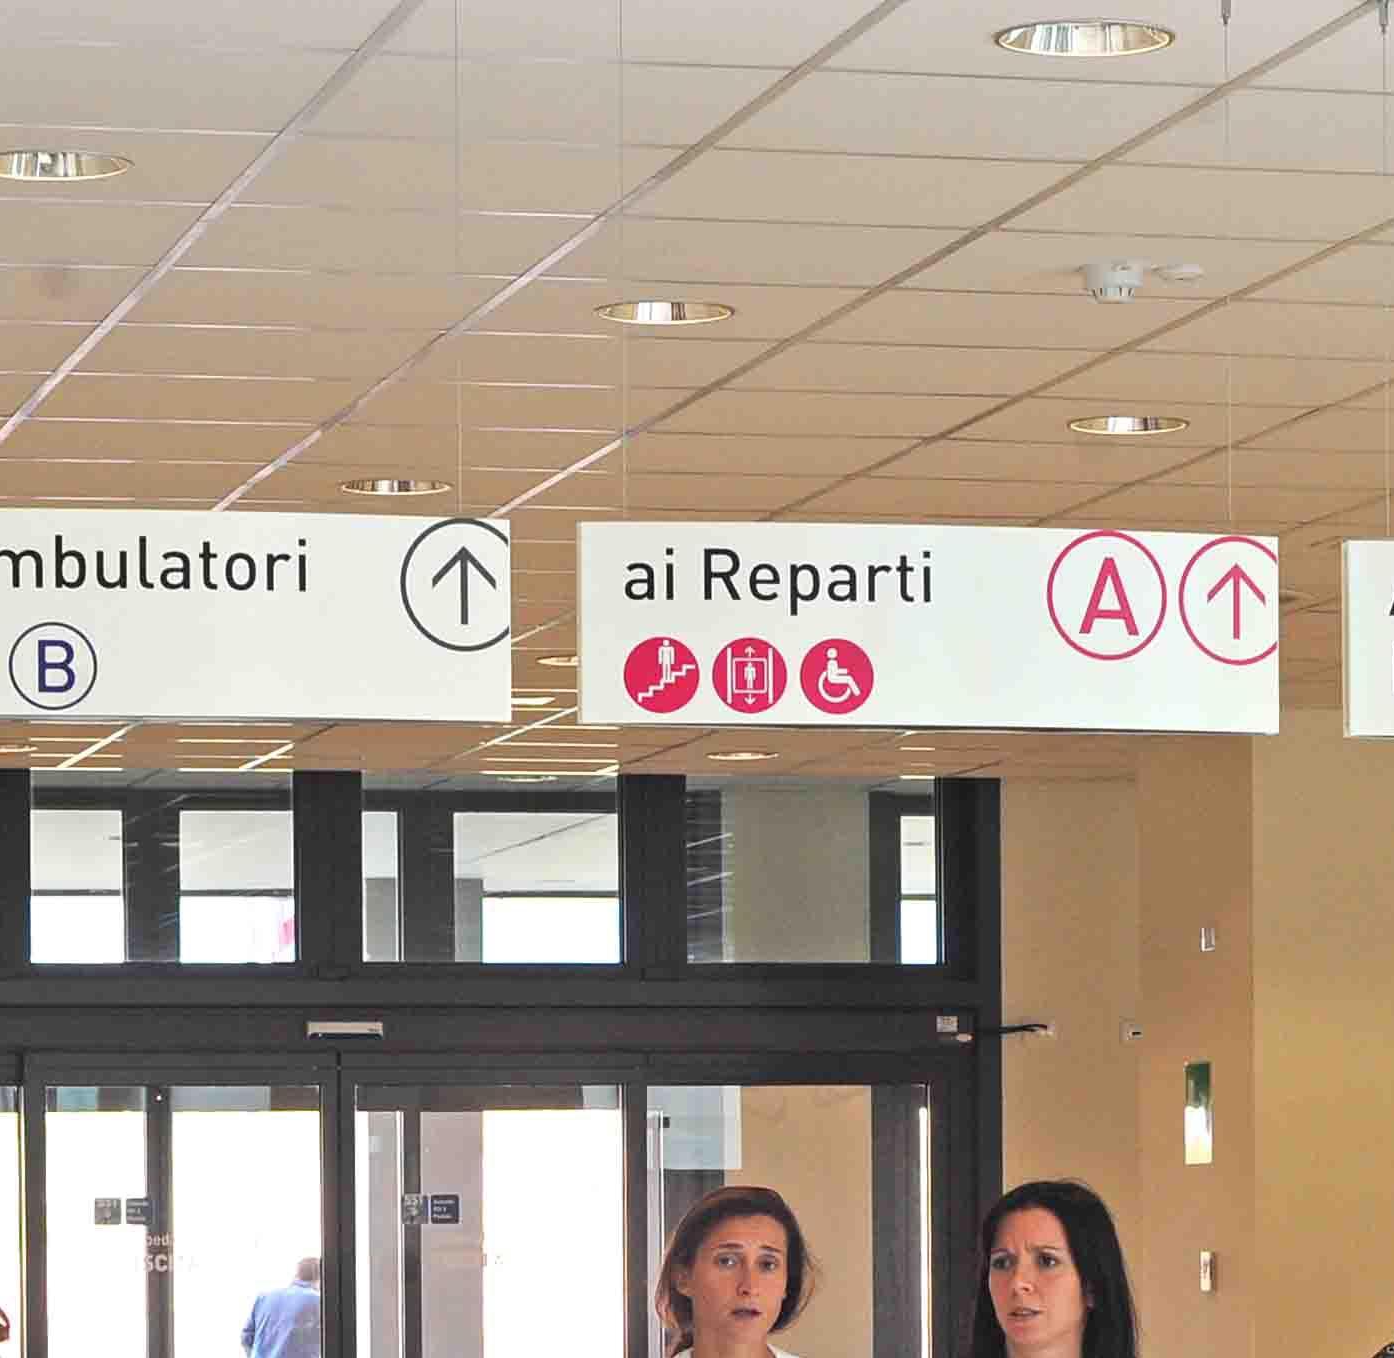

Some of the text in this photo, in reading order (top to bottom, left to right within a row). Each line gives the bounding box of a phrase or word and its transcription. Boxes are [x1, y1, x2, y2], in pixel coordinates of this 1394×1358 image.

[623, 547, 934, 617] ai Reparti
[1078, 556, 1140, 637] A
[37, 639, 76, 694] B
